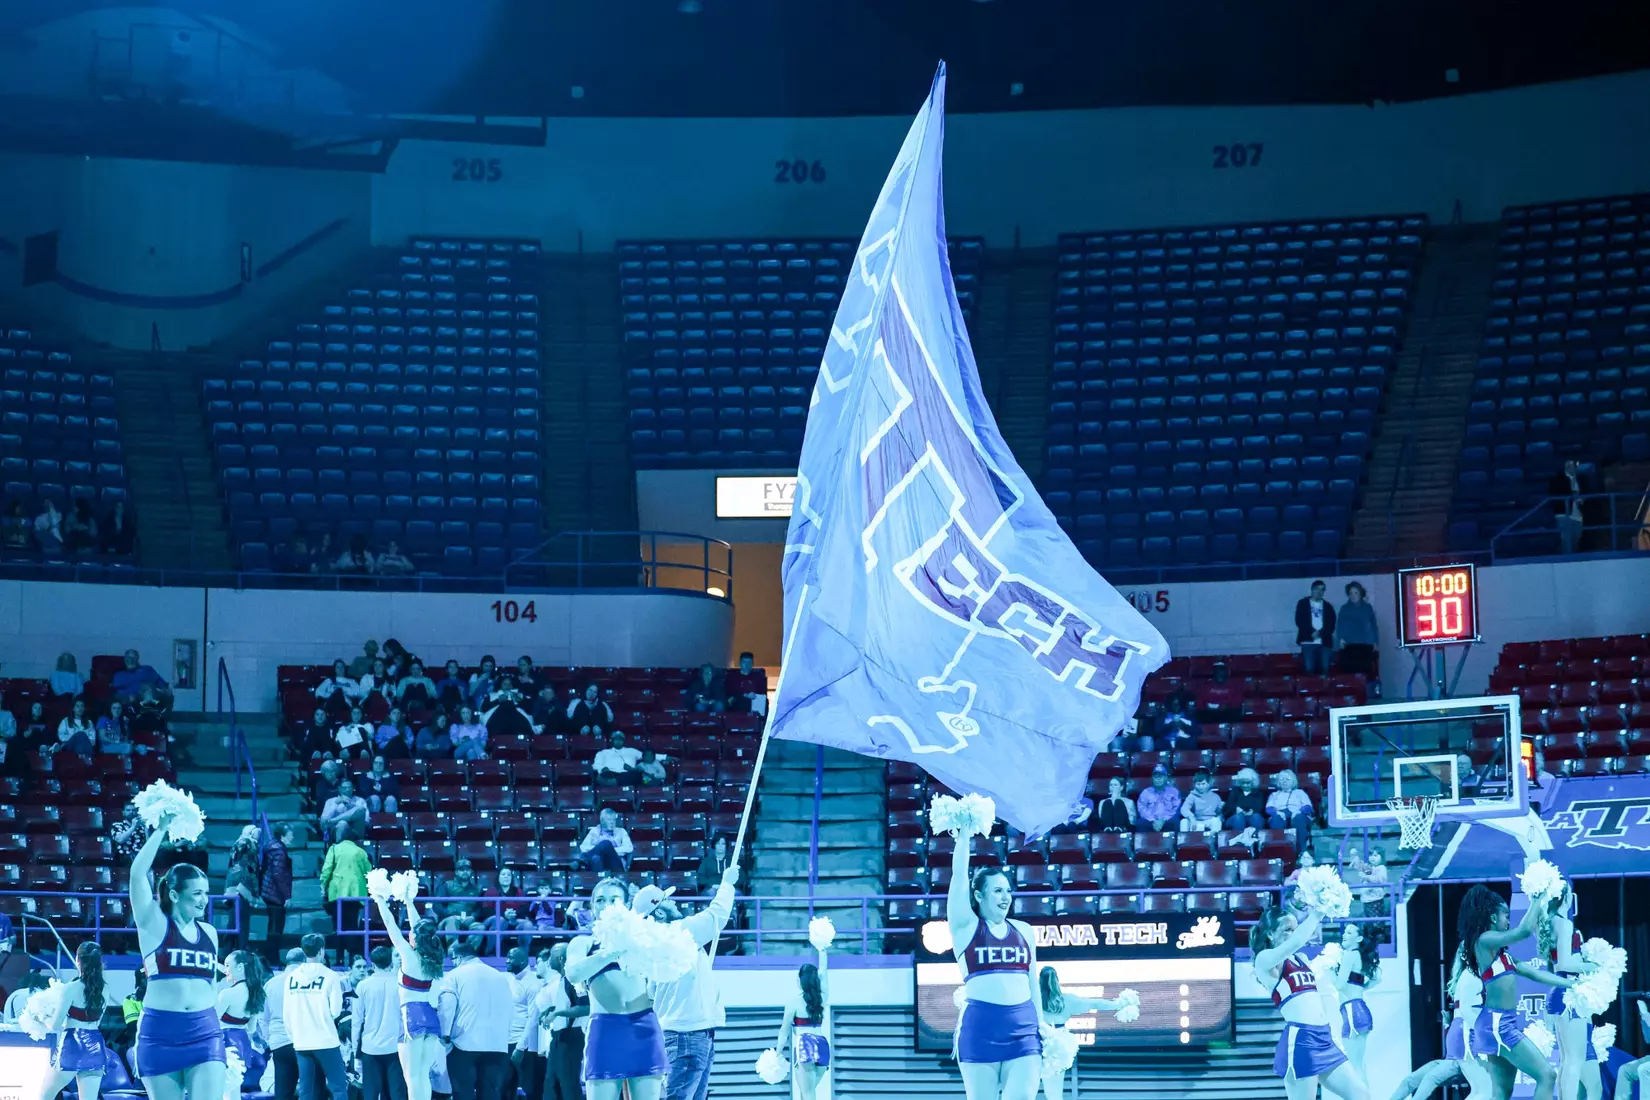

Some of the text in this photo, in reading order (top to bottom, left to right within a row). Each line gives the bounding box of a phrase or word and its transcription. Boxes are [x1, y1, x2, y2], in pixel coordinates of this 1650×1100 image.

[1213, 143, 1264, 168] 207
[452, 158, 502, 181] 205
[775, 159, 826, 184] 206
[1416, 573, 1467, 596] 10:00
[491, 600, 537, 623] 104
[1127, 590, 1170, 613] 105
[1417, 597, 1462, 636] 30
[1101, 923, 1168, 945] TECH
[167, 948, 218, 970] TECH
[974, 946, 1028, 964] TECH
